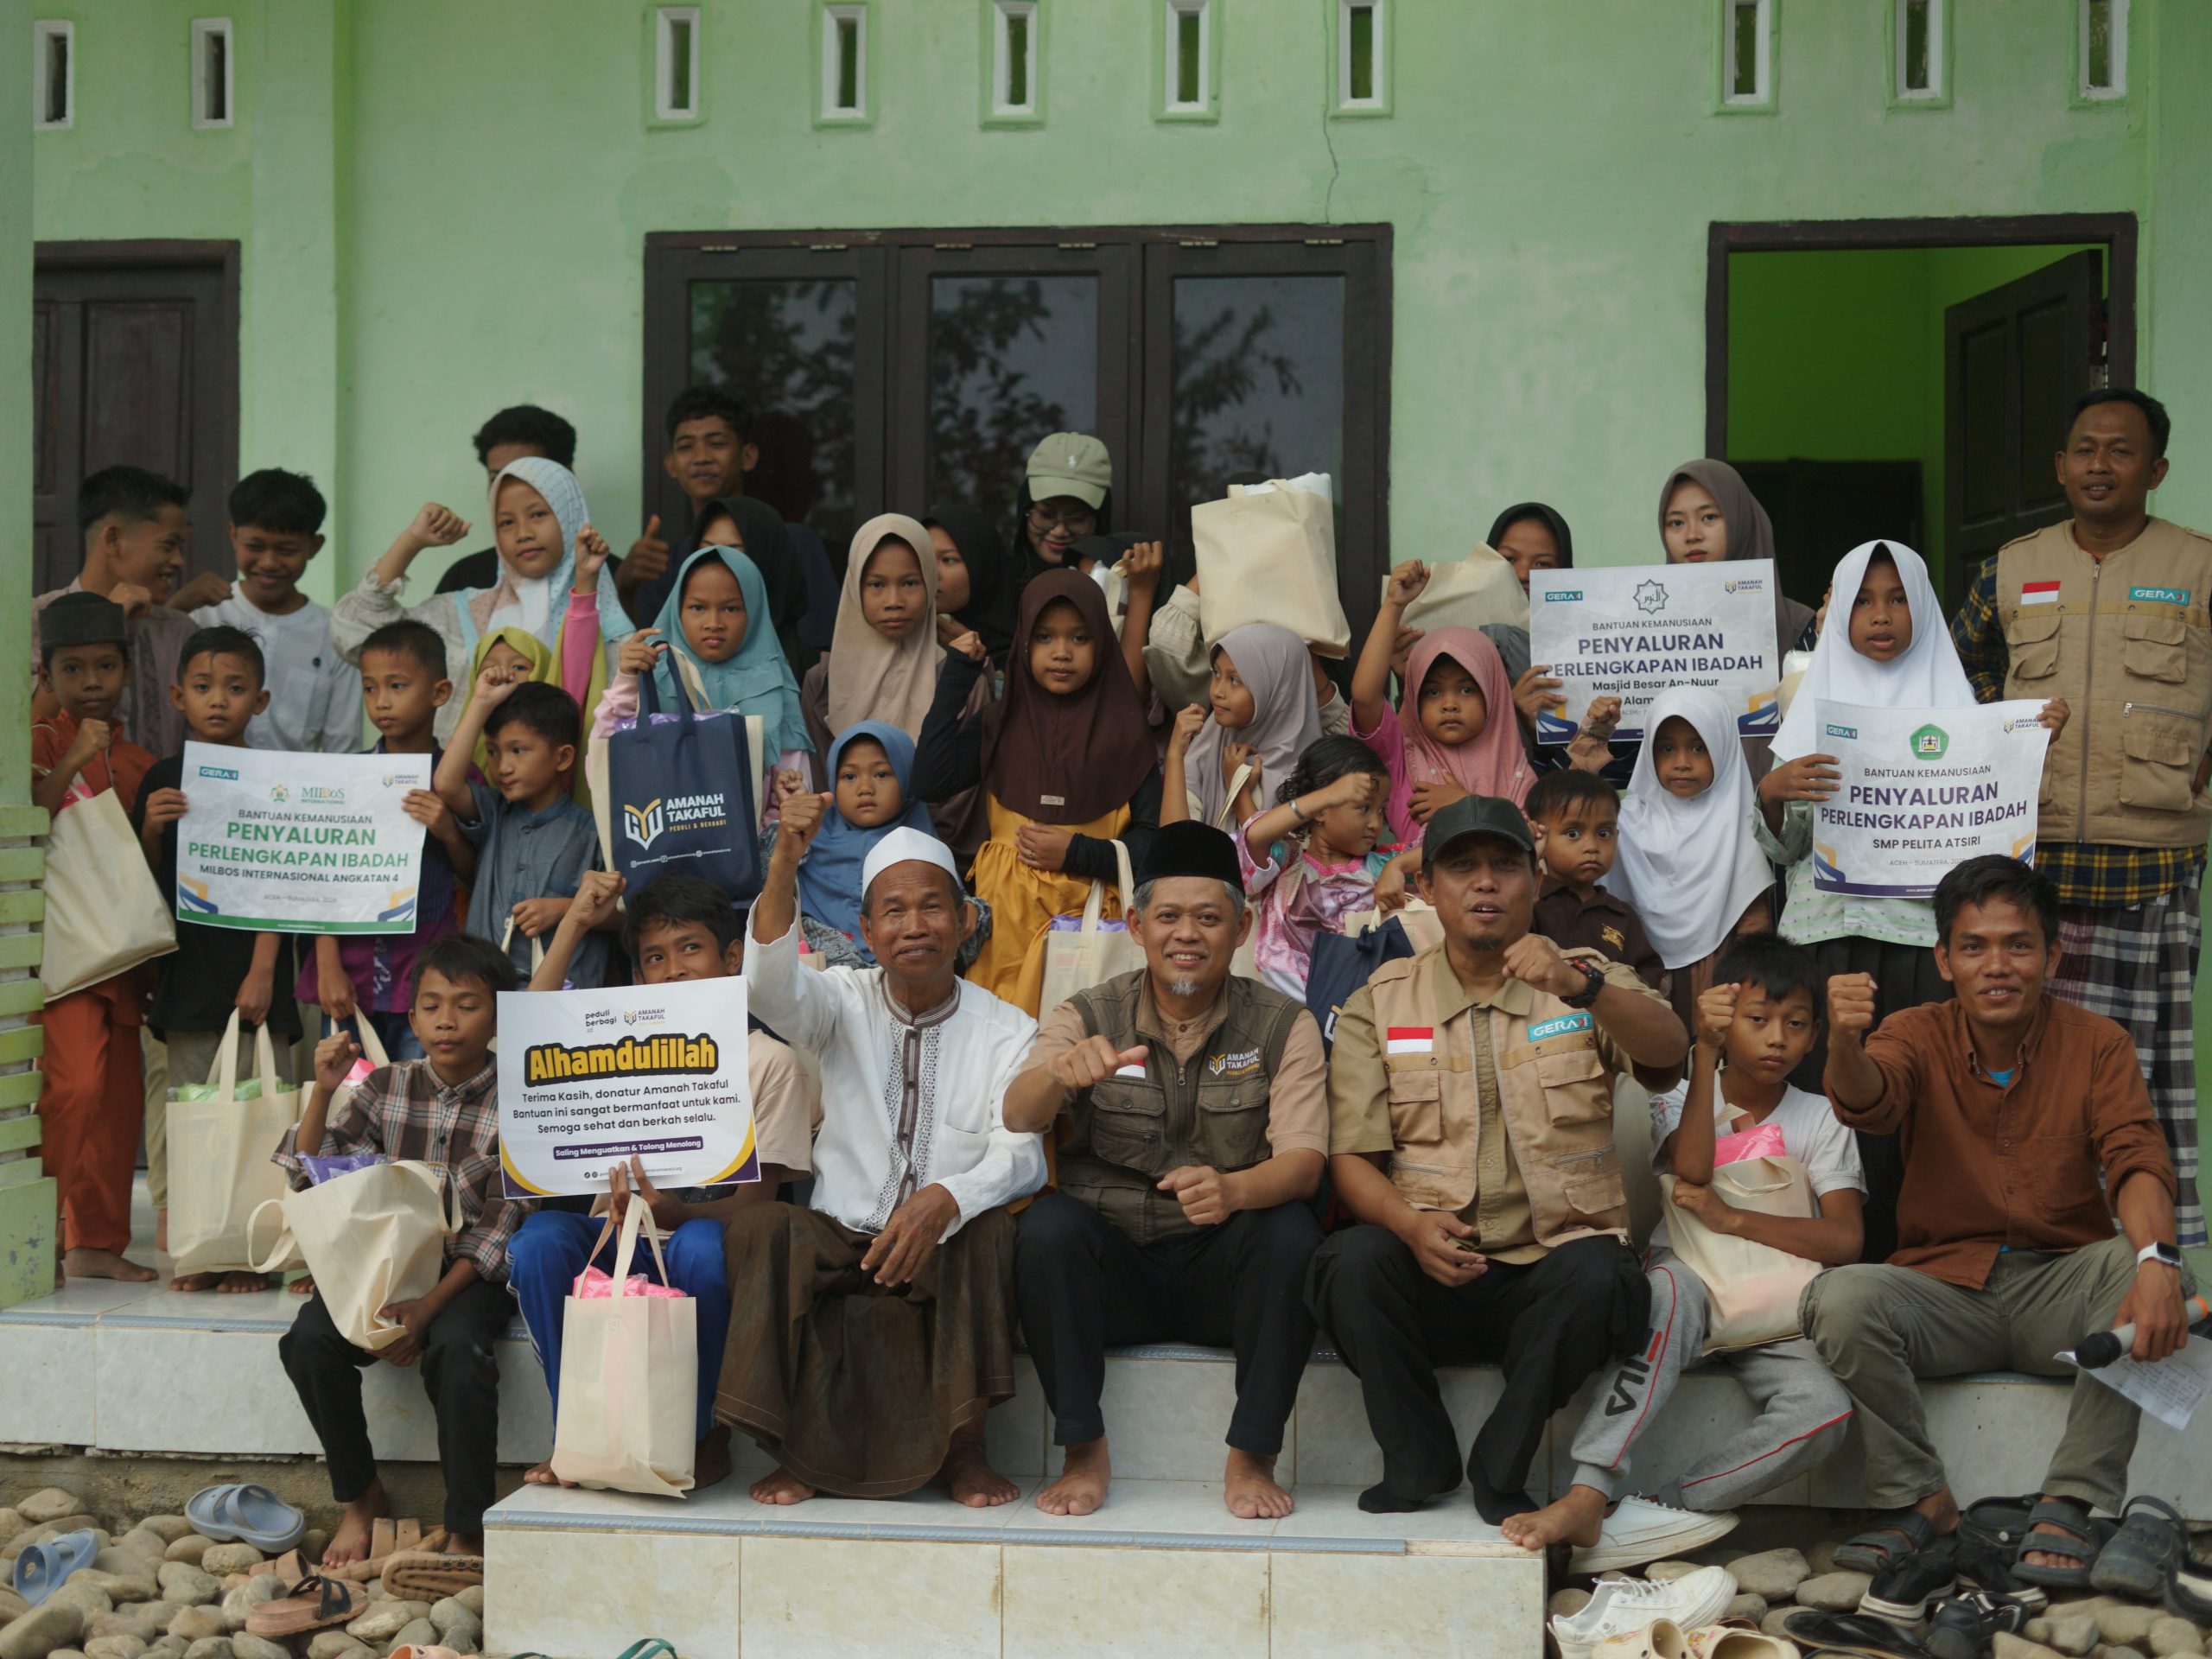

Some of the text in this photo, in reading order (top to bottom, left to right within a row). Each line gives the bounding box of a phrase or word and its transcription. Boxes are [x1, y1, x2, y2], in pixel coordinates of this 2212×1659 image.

[2134, 589, 2185, 602] GERAK
[1592, 618, 1712, 631] BANTUAN KEMANUSIAAN
[1579, 633, 1723, 654] PENYALURAN
[1692, 656, 1763, 671] IBADAH
[1592, 680, 1630, 692] Masjid
[1634, 679, 1666, 689] Besar
[1827, 726, 1856, 738] GERAK
[200, 767, 237, 779] GERAK
[1865, 766, 1991, 777] BANTUAN KEMANUSIAAN
[666, 793, 724, 810] AMANAH
[1851, 782, 1999, 805] PENYALURAN
[238, 809, 372, 823] BANTUAN KEMANUSIAAN
[666, 805, 726, 823] TAKAFUL
[1821, 801, 2026, 829] PERLENGKAPAN IBADAH
[227, 822, 376, 845] PENYALURAN
[1873, 836, 1980, 849] SMP PELITA ATSIRI
[188, 842, 408, 868] PERLENGKAPAN IBADAH
[200, 865, 398, 882] MILBOS INTERNASIONAL ANGKATAN 4
[586, 1009, 610, 1020] peduli
[586, 1016, 617, 1027] berbagi
[1533, 1016, 1588, 1036] GERAK
[530, 1038, 715, 1080] Alhamdulillah
[1226, 1055, 1260, 1069] TAKAFUL
[1227, 1047, 1259, 1061] AMANAH
[523, 1080, 728, 1103] Terima Kasih, donatur Amanah Takaful
[513, 1094, 741, 1119] Bantuan ini sangat bermanfaat untuk kami.
[538, 1113, 715, 1135] Semoga sehat dan berkah selalu.
[556, 1148, 579, 1158] Saling
[581, 1145, 630, 1157] Menguatkan
[639, 1143, 664, 1154] Tolong
[666, 1140, 701, 1150] Menolong
